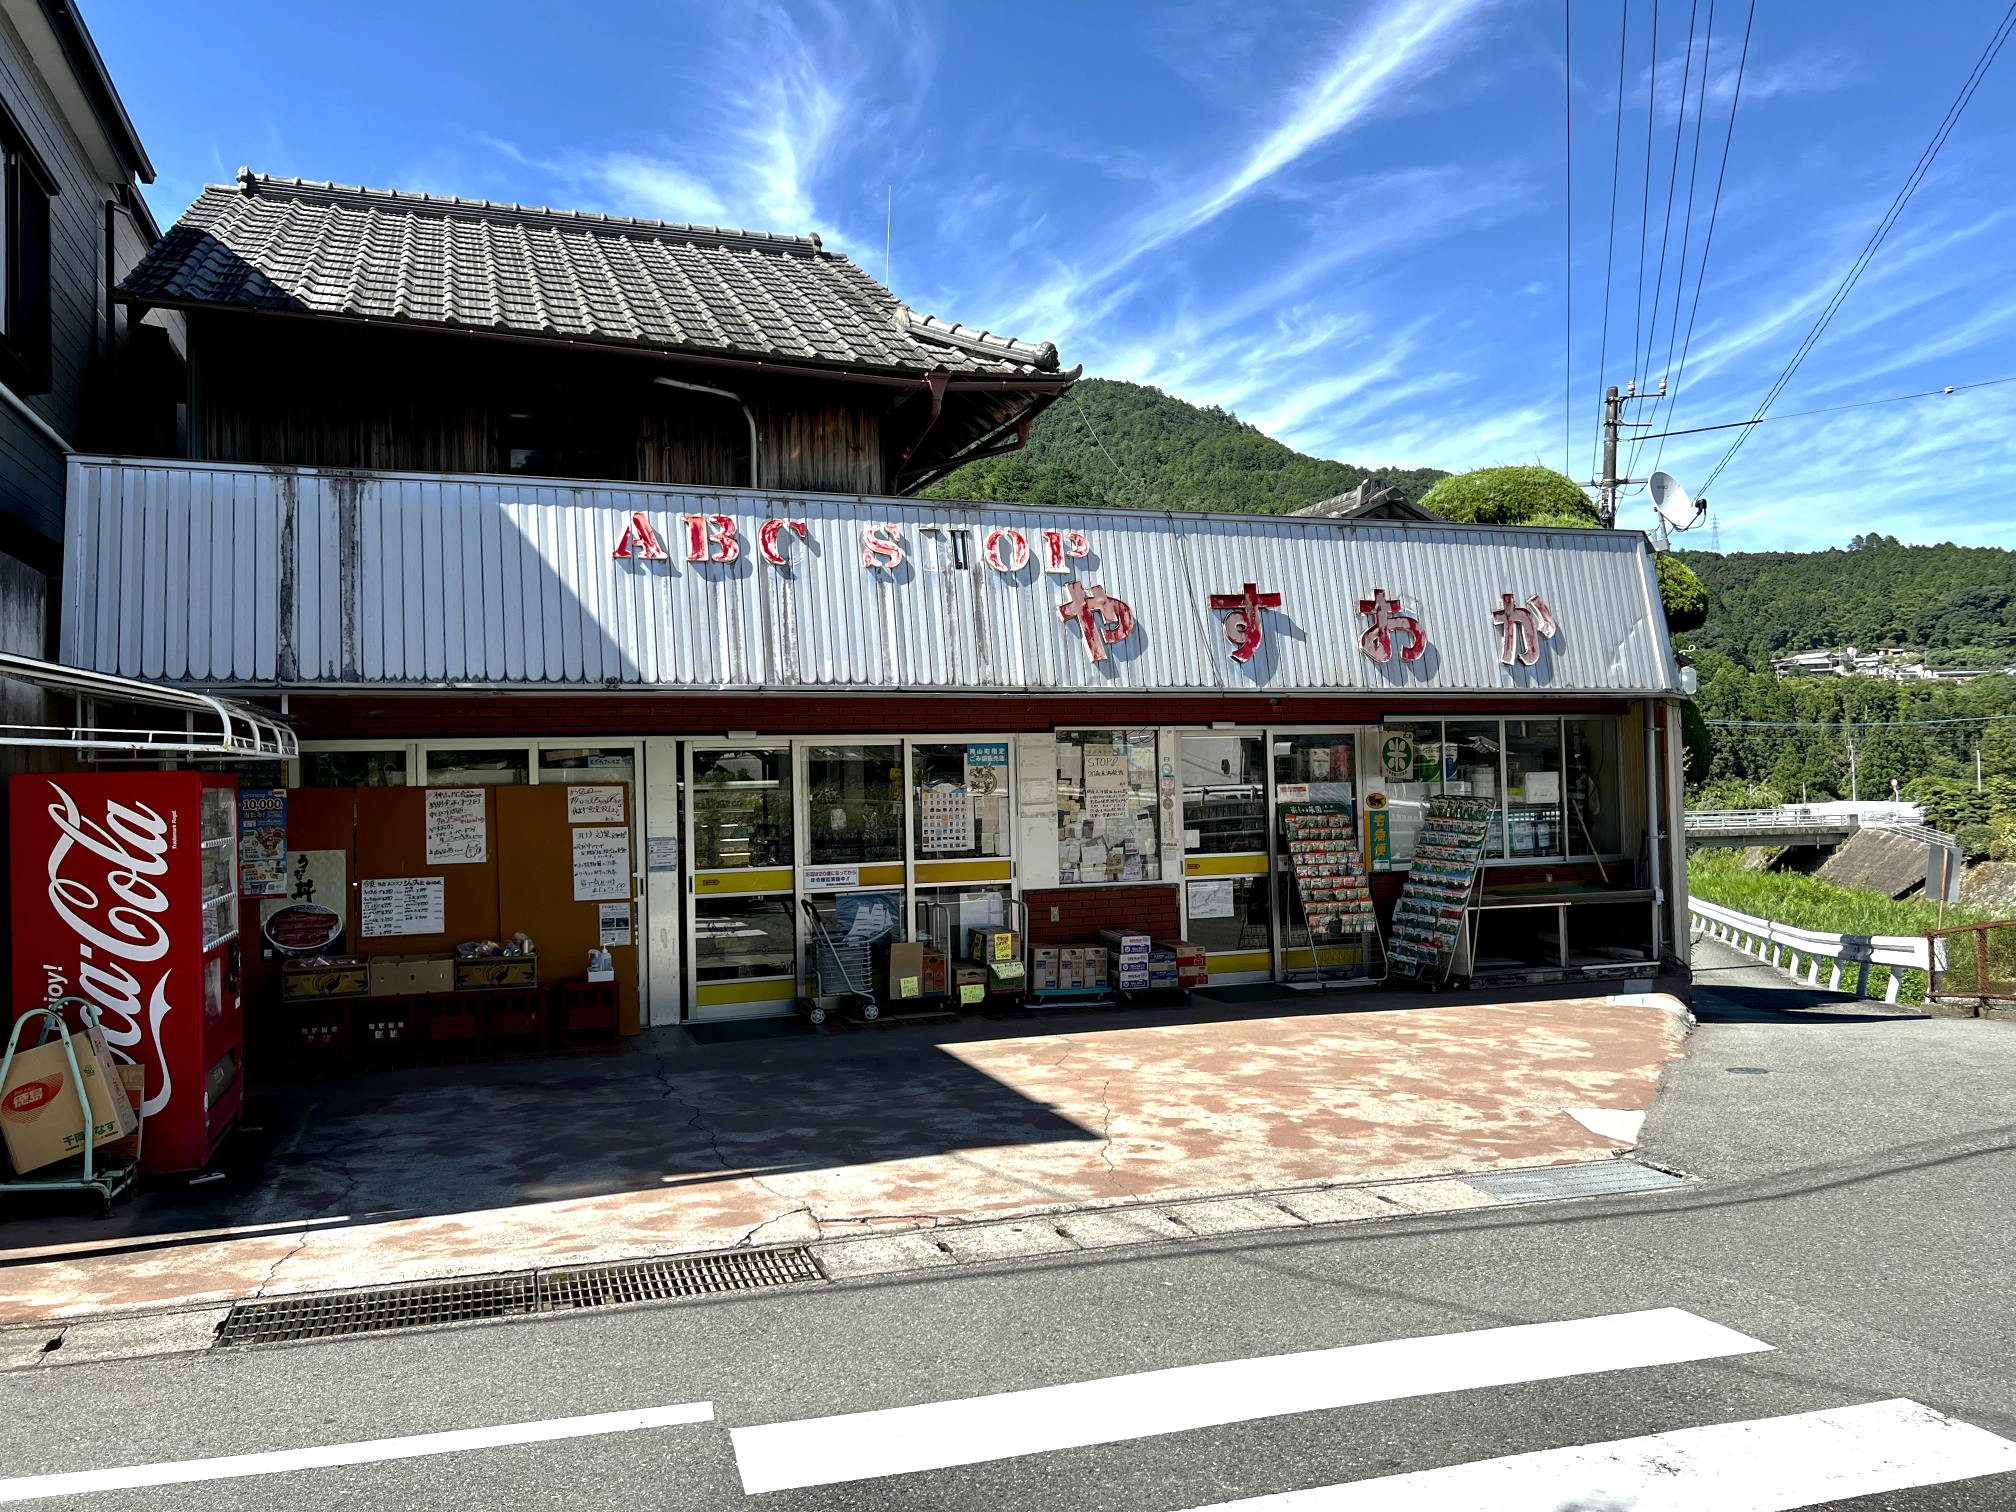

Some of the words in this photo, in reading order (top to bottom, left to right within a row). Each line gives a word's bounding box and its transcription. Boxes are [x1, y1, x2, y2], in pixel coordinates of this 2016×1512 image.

[612, 511, 807, 566] ABC
[1056, 580, 1557, 667] やすおか
[969, 747, 1005, 755] 神山町指定
[1374, 814, 1387, 857] 宅急便
[48, 781, 172, 1067] ca-Cola
[13, 1087, 43, 1109] 徳島
